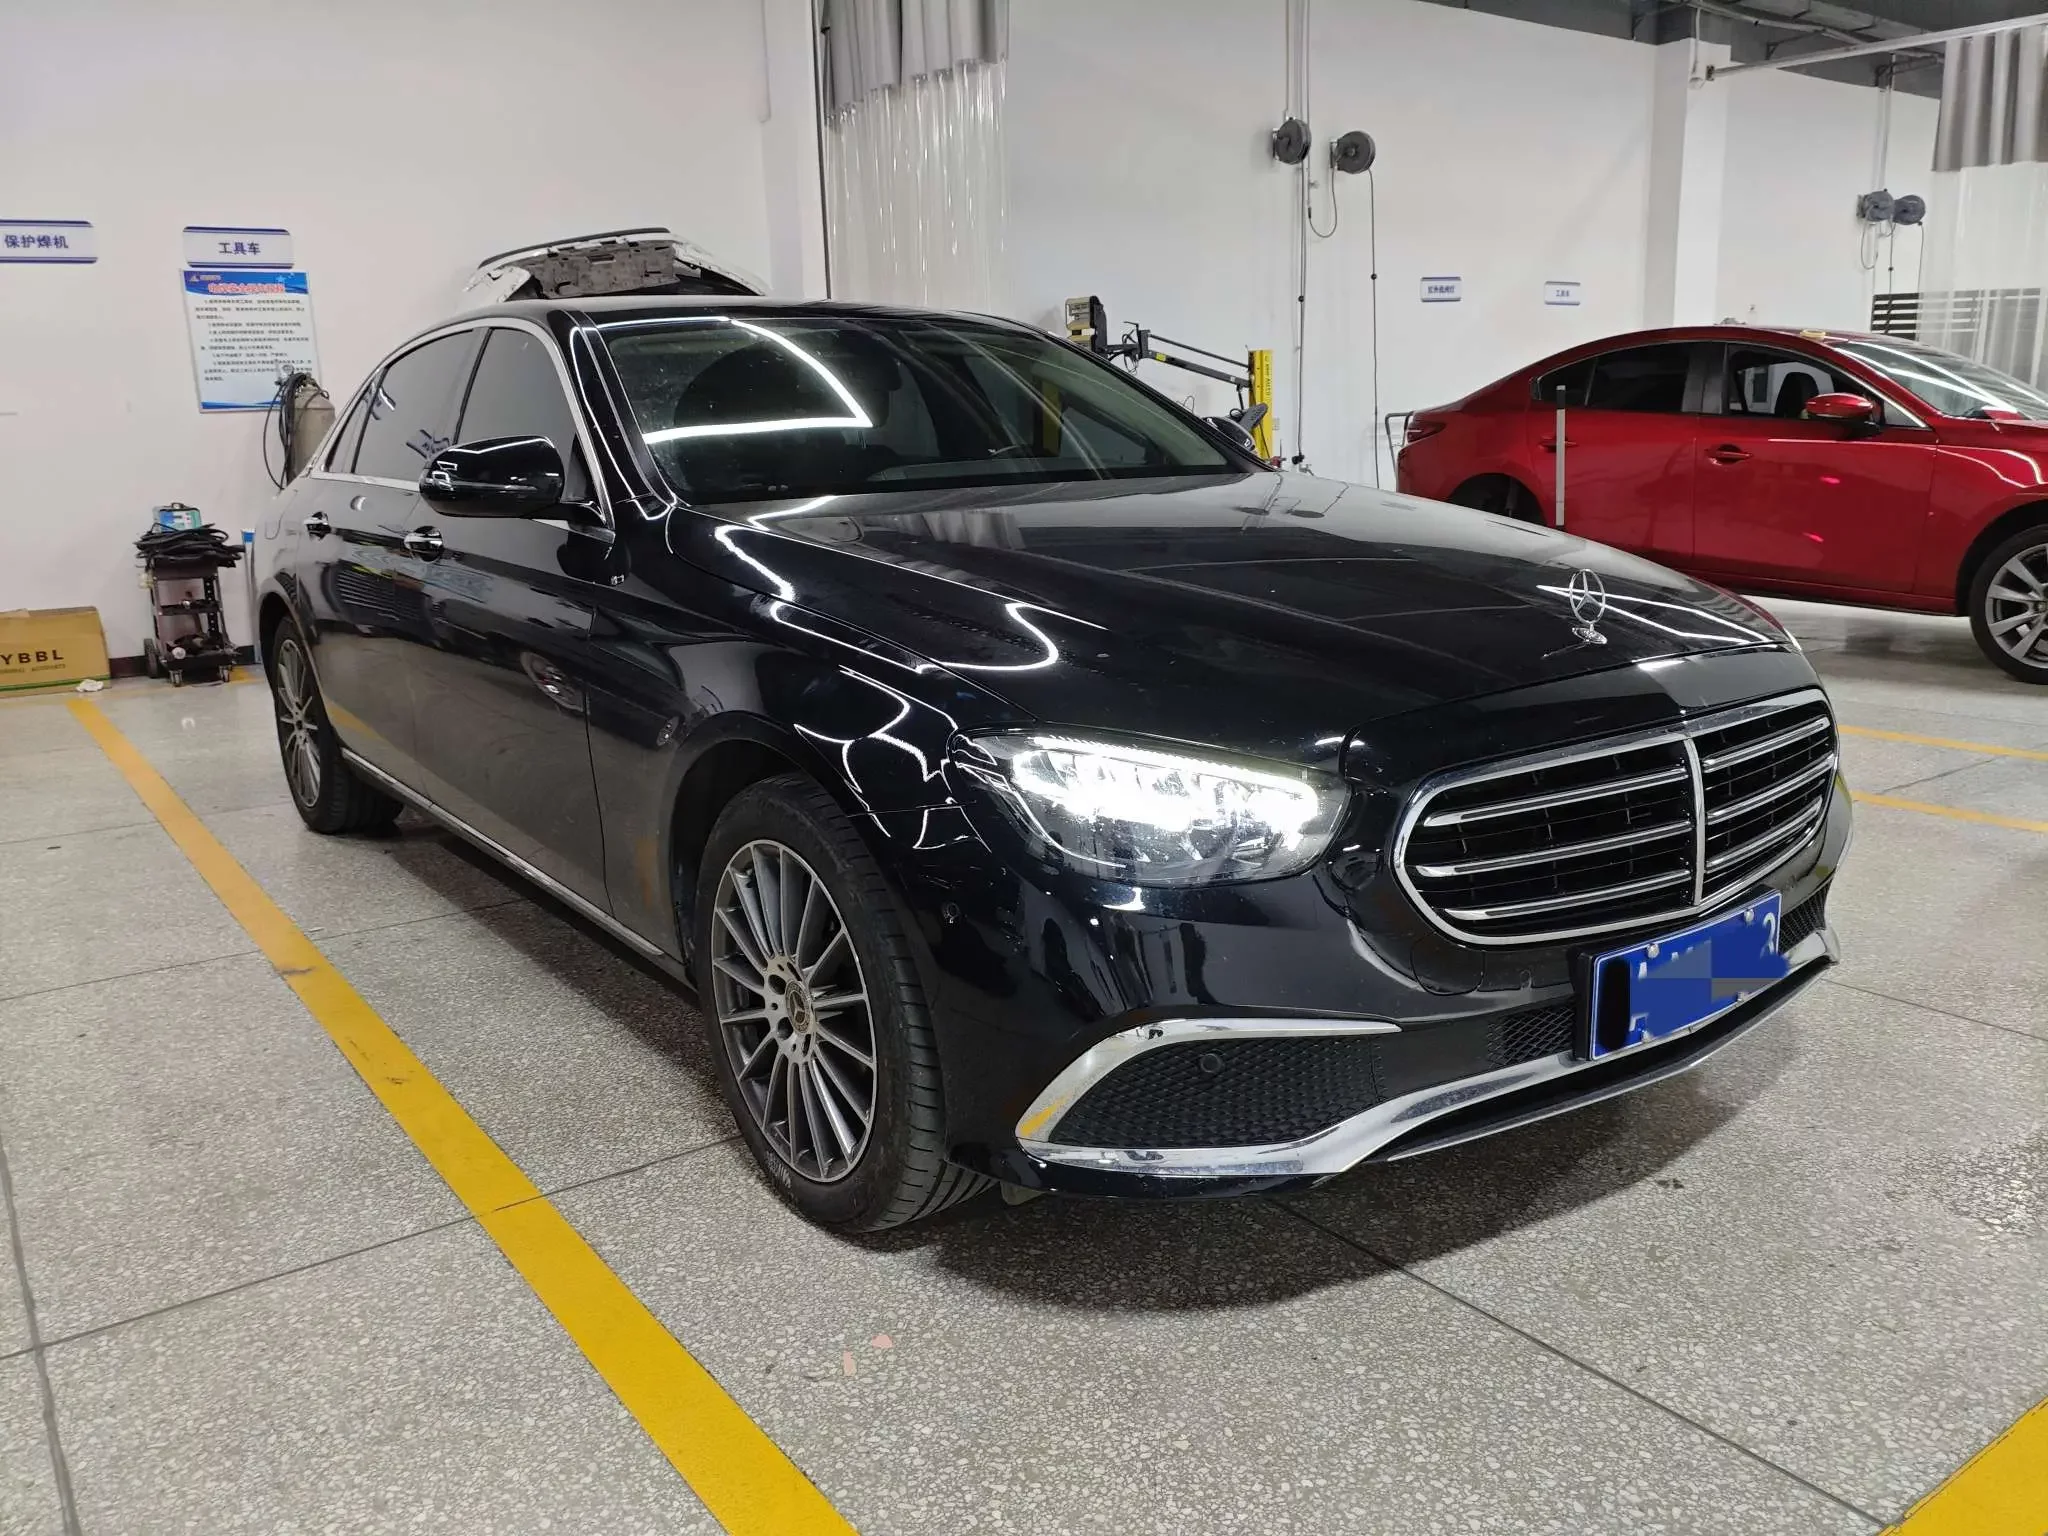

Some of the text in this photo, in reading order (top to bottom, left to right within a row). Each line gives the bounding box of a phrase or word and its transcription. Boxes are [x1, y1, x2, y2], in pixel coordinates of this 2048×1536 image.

[4, 234, 69, 249] 保护焊机
[218, 241, 261, 255] 工具车
